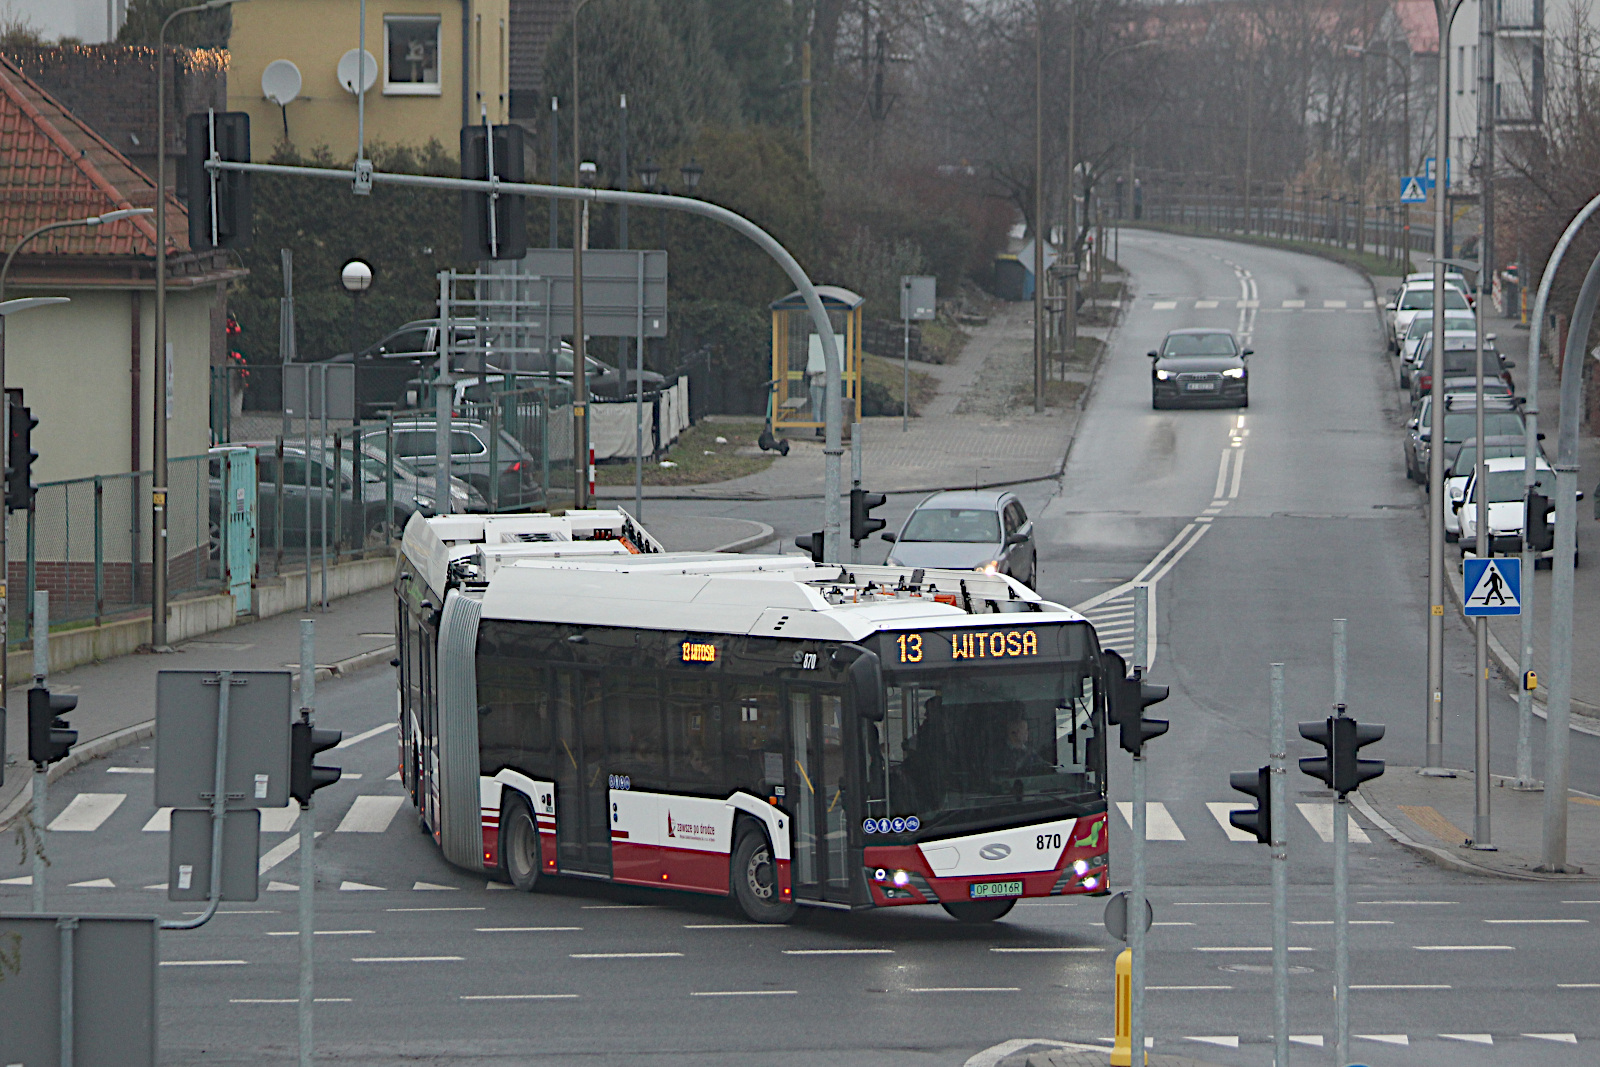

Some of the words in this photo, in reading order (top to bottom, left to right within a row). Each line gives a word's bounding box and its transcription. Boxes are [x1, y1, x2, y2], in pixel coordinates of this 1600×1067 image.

[682, 642, 691, 661] 13
[691, 643, 715, 661] WITOSA
[896, 633, 923, 663] 13
[952, 630, 1038, 659] WITOSA
[803, 653, 817, 669] 870
[1036, 833, 1061, 850] 870
[976, 884, 989, 895] OP
[991, 882, 1020, 894] 0016R
